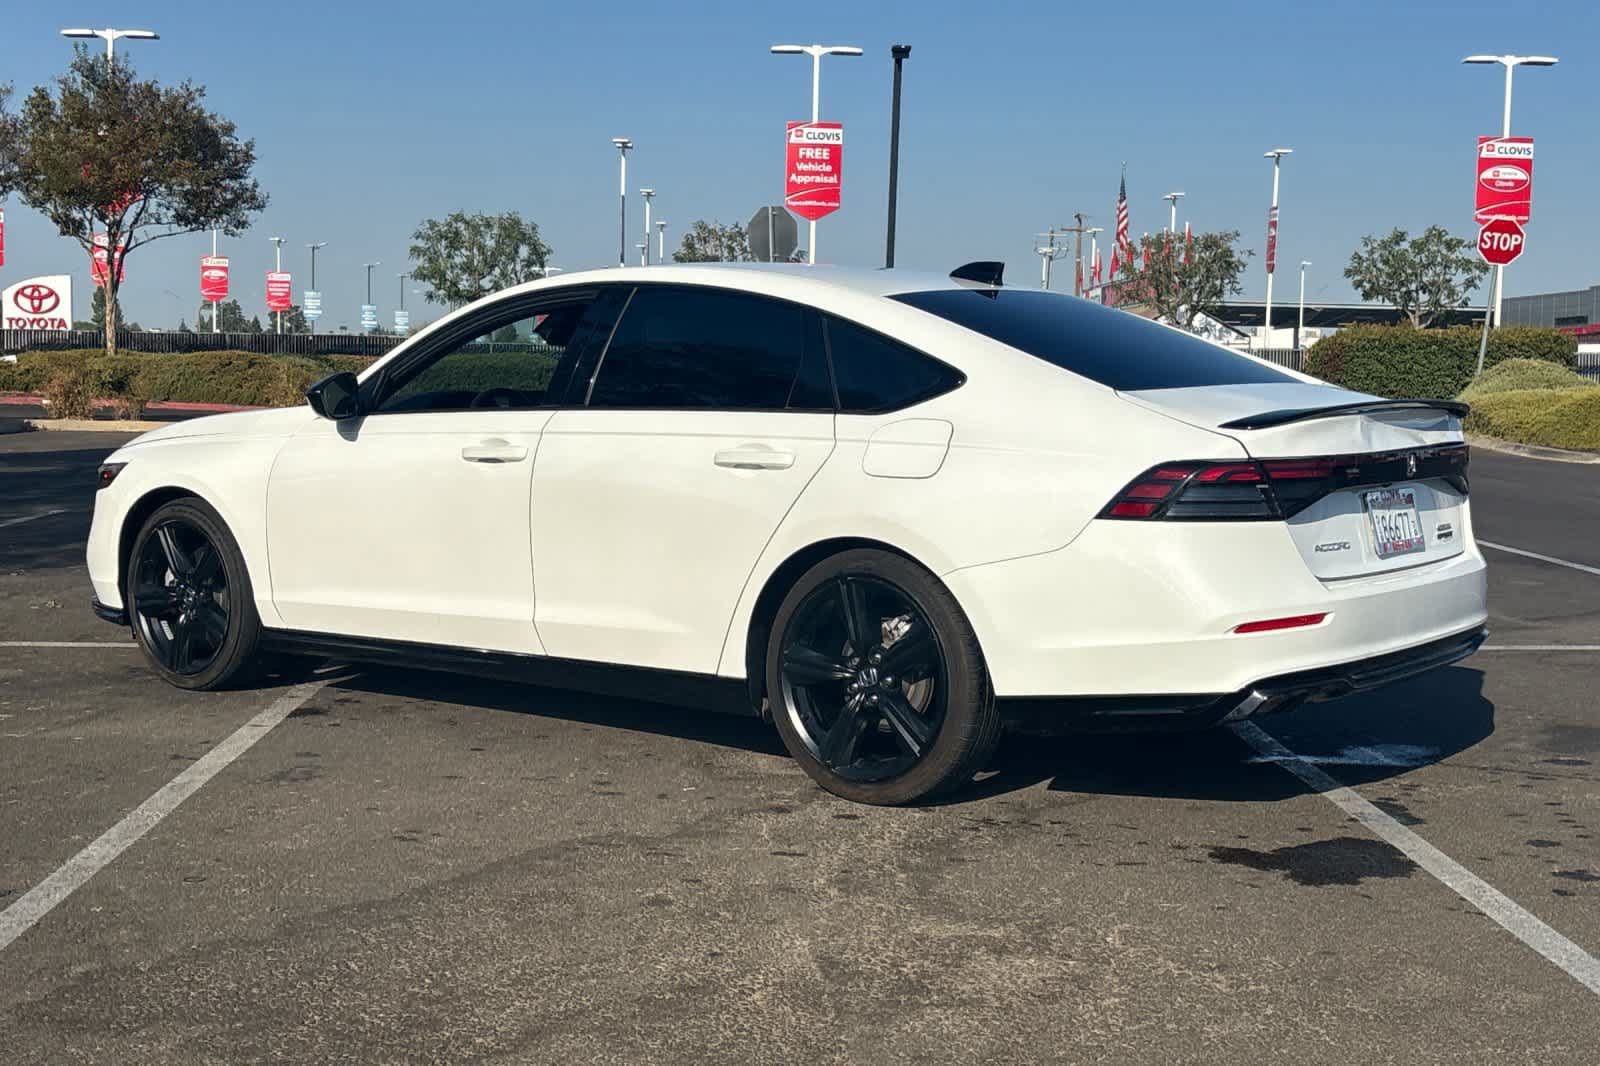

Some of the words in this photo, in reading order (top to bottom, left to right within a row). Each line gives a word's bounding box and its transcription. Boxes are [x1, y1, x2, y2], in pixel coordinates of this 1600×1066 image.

[806, 131, 841, 141] CLOVIS
[799, 147, 831, 160] FREE
[1497, 146, 1532, 156] CLOVIS
[796, 162, 832, 172] Vehicle
[789, 173, 838, 185] Appraisal
[1481, 231, 1522, 252] STOP
[6, 317, 68, 329] TOYOTA
